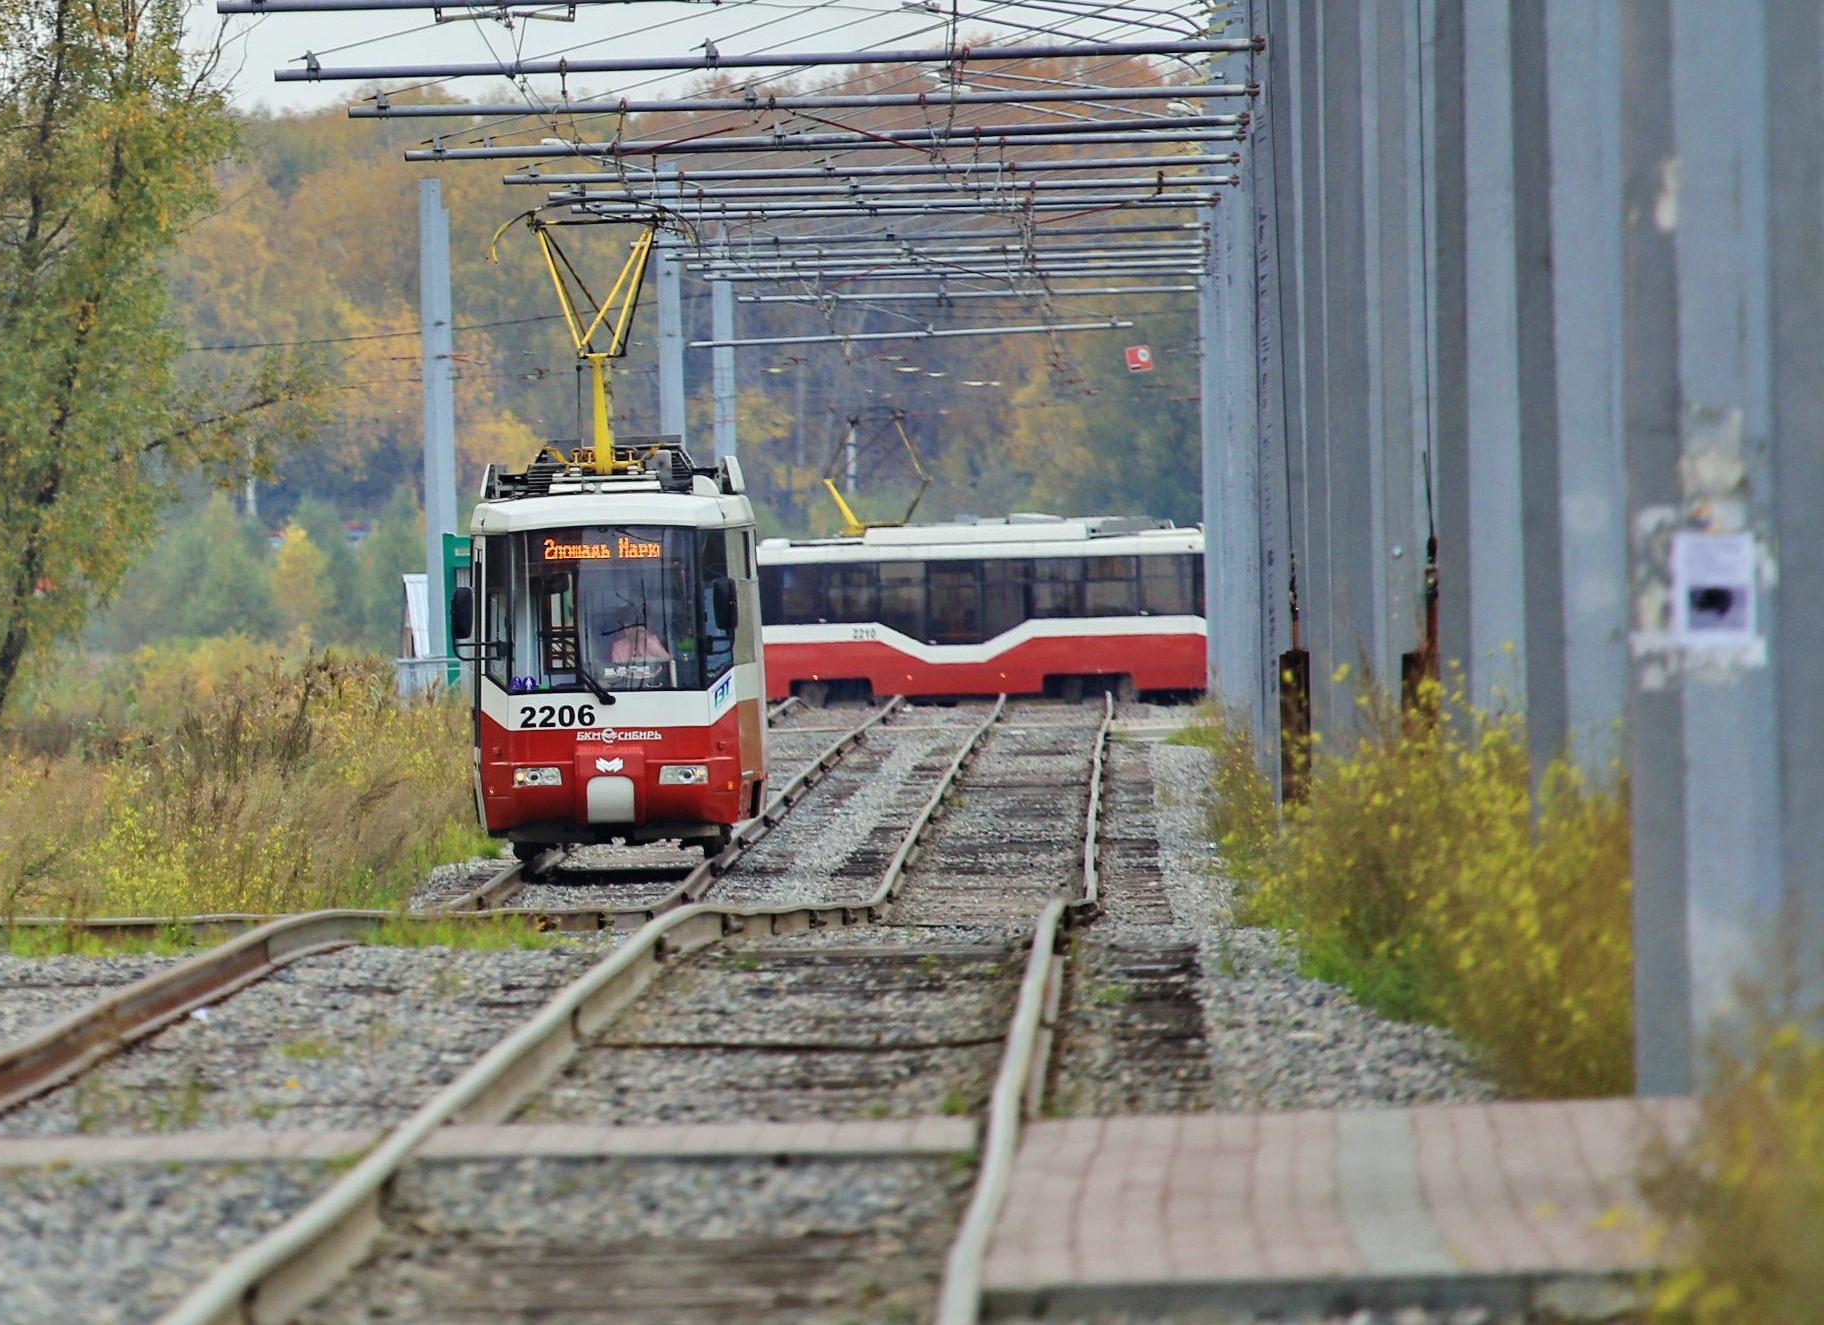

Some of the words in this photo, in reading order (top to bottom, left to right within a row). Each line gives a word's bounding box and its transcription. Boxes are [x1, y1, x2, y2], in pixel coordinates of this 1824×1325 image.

[618, 537, 660, 558] Марк
[520, 705, 595, 728] 2206
[576, 731, 601, 741] БКМ
[617, 730, 663, 740] СИБИРЬ
